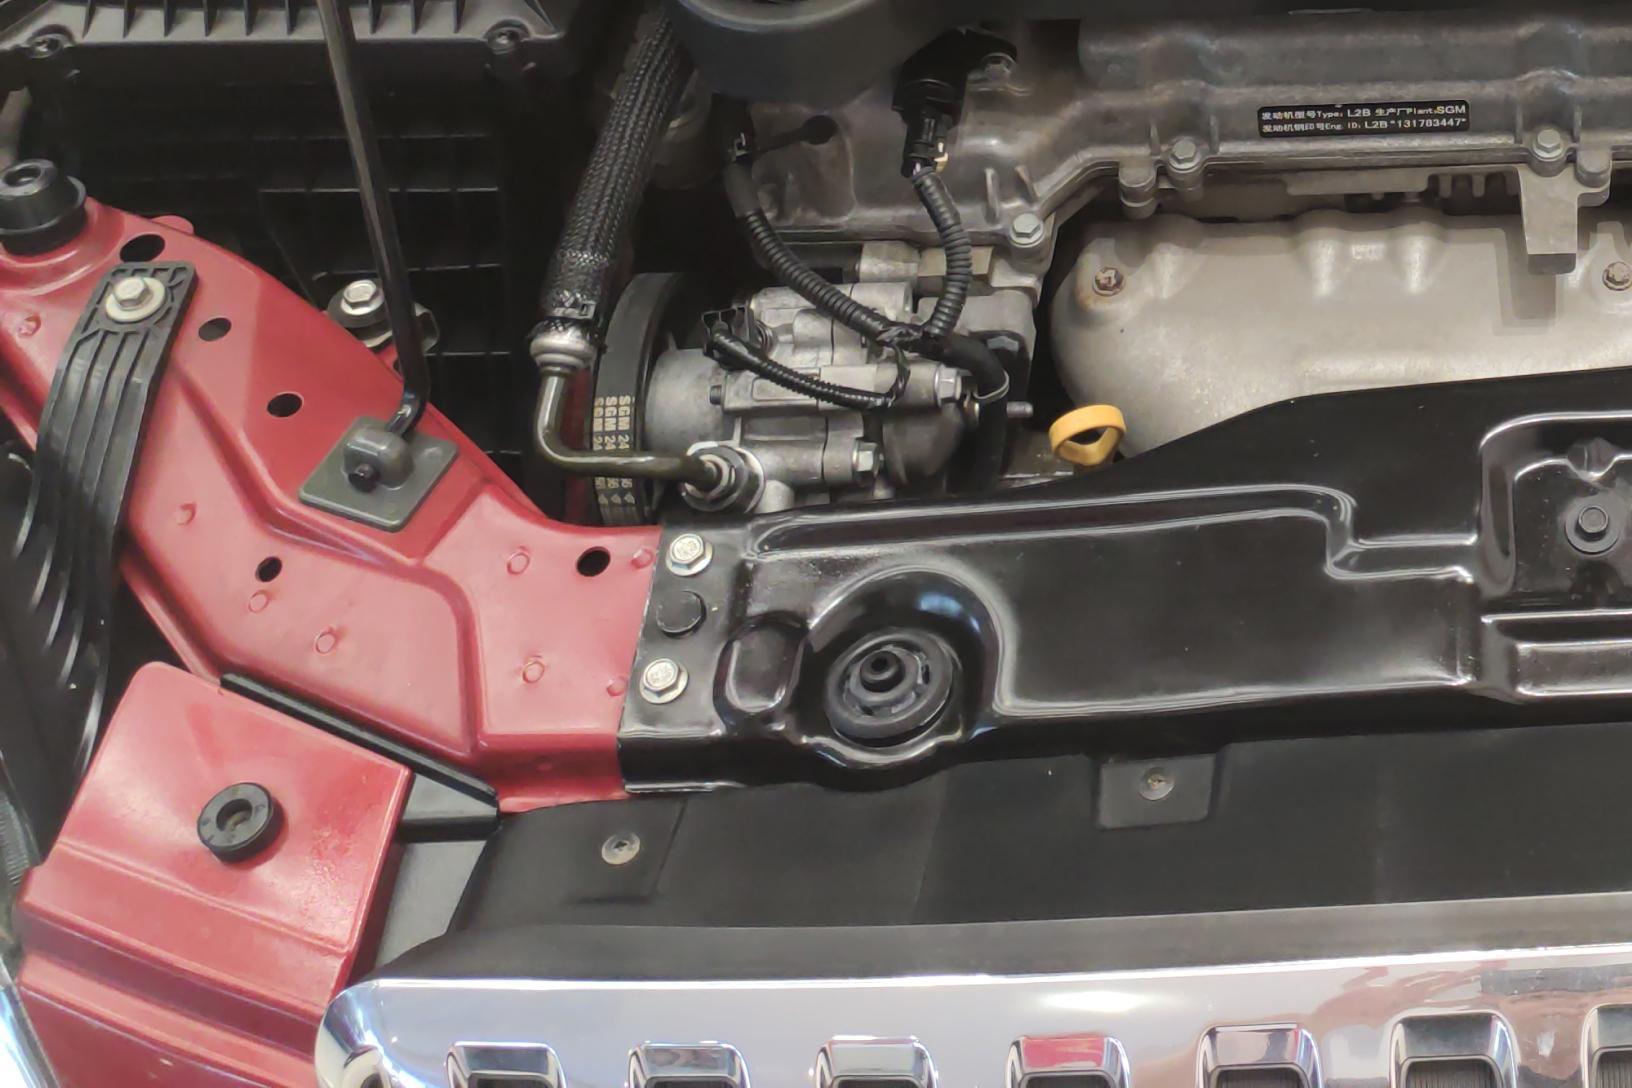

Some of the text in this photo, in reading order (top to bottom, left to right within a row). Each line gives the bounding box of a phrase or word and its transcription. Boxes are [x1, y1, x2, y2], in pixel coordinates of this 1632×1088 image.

[1347, 108, 1371, 117] L2B
[605, 396, 618, 431] SGM
[618, 395, 631, 431] SGM
